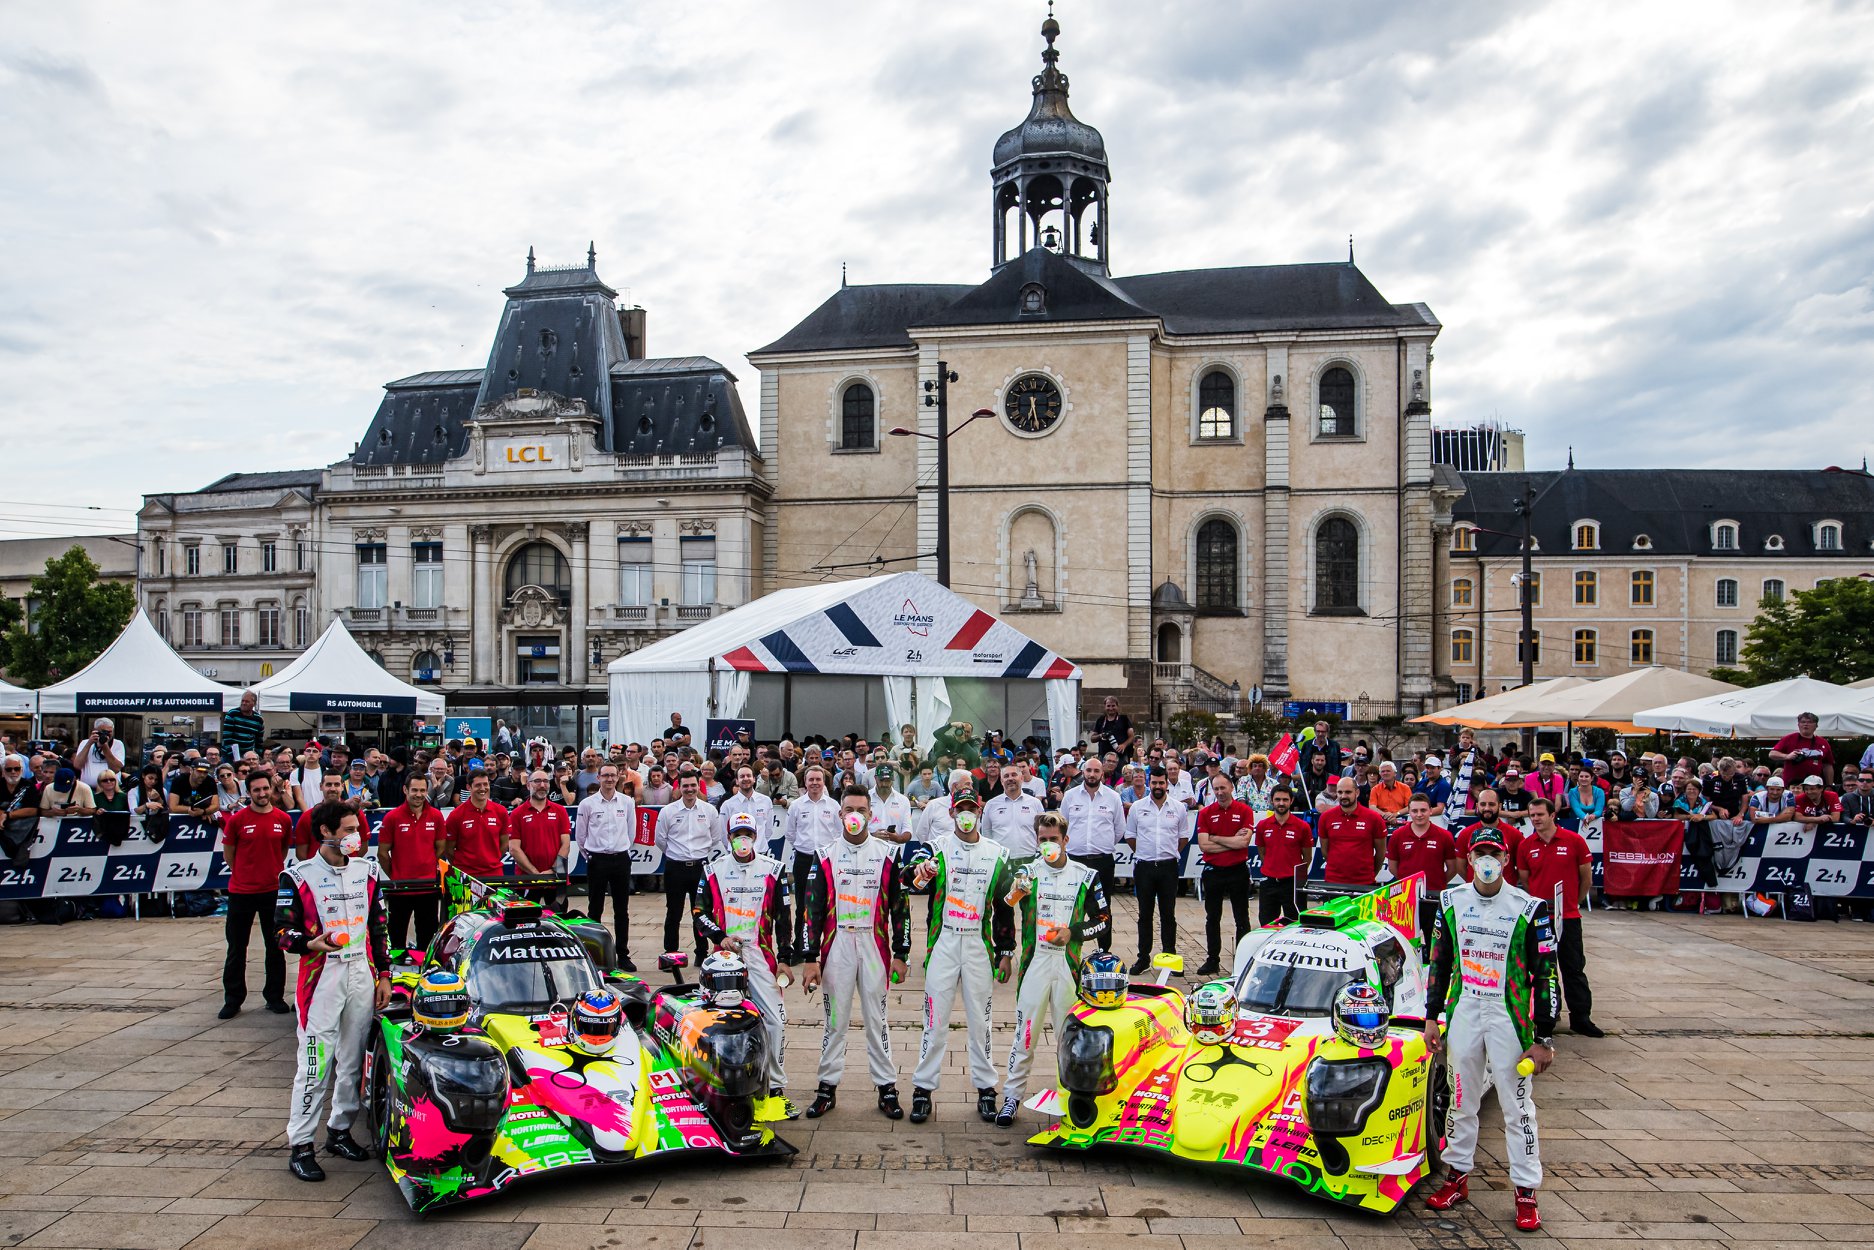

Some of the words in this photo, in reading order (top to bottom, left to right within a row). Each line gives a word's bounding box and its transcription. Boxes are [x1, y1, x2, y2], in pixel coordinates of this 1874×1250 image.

[507, 446, 552, 463] LCL
[894, 614, 905, 623] LE
[907, 615, 934, 624] MANS
[85, 698, 146, 706] ORPHEOGRAFF
[152, 698, 163, 706] RS
[164, 698, 215, 706] AUTOMOBILE
[175, 824, 208, 840] 24h
[1586, 827, 1602, 840] 24
[1775, 832, 1804, 845] 24h
[1823, 832, 1856, 848] 24h
[630, 849, 653, 863] 24h
[1609, 851, 1675, 860] REBELLION
[1, 868, 36, 886] 24h
[58, 866, 92, 882] 24h
[113, 864, 146, 881] 24h
[166, 862, 199, 878] 24h
[1765, 866, 1796, 881] 24h
[1815, 868, 1847, 883] 24h
[1082, 921, 1107, 936] MOTUL
[1467, 925, 1509, 937] REBELLION
[489, 931, 574, 944] REBELLION
[489, 944, 585, 961] Matmut
[1260, 948, 1348, 970] Matmut
[1471, 950, 1505, 962] SYNERGIE
[424, 994, 467, 1003] REBELLION
[1341, 1007, 1389, 1015] REBELLION
[578, 1015, 618, 1023] REBELLION
[1243, 1021, 1275, 1037] 3
[302, 1035, 317, 1116] REBELLION
[650, 1071, 676, 1087] P1
[652, 1091, 690, 1104] MOTUL
[1132, 1090, 1171, 1103] MOTUL
[1187, 1087, 1240, 1106] TVR
[1289, 1093, 1302, 1106] P
[404, 1104, 428, 1123] PORT
[508, 1110, 548, 1121] MOTUL
[660, 1103, 708, 1114] NORTHWIRE
[1128, 1102, 1173, 1115] NORTHWIRE
[1388, 1097, 1425, 1122] GREENTECH
[669, 1117, 710, 1127] LEMO
[1126, 1113, 1170, 1126] LEMO
[1269, 1113, 1304, 1124] MOTU
[510, 1121, 565, 1136] NORTHWIRE
[522, 1134, 570, 1149] LEMO
[1362, 1135, 1385, 1146] IDEC
[1385, 1127, 1409, 1143] SPORT
[1270, 1138, 1319, 1158] LEMO
[1216, 1142, 1349, 1200] LLION
